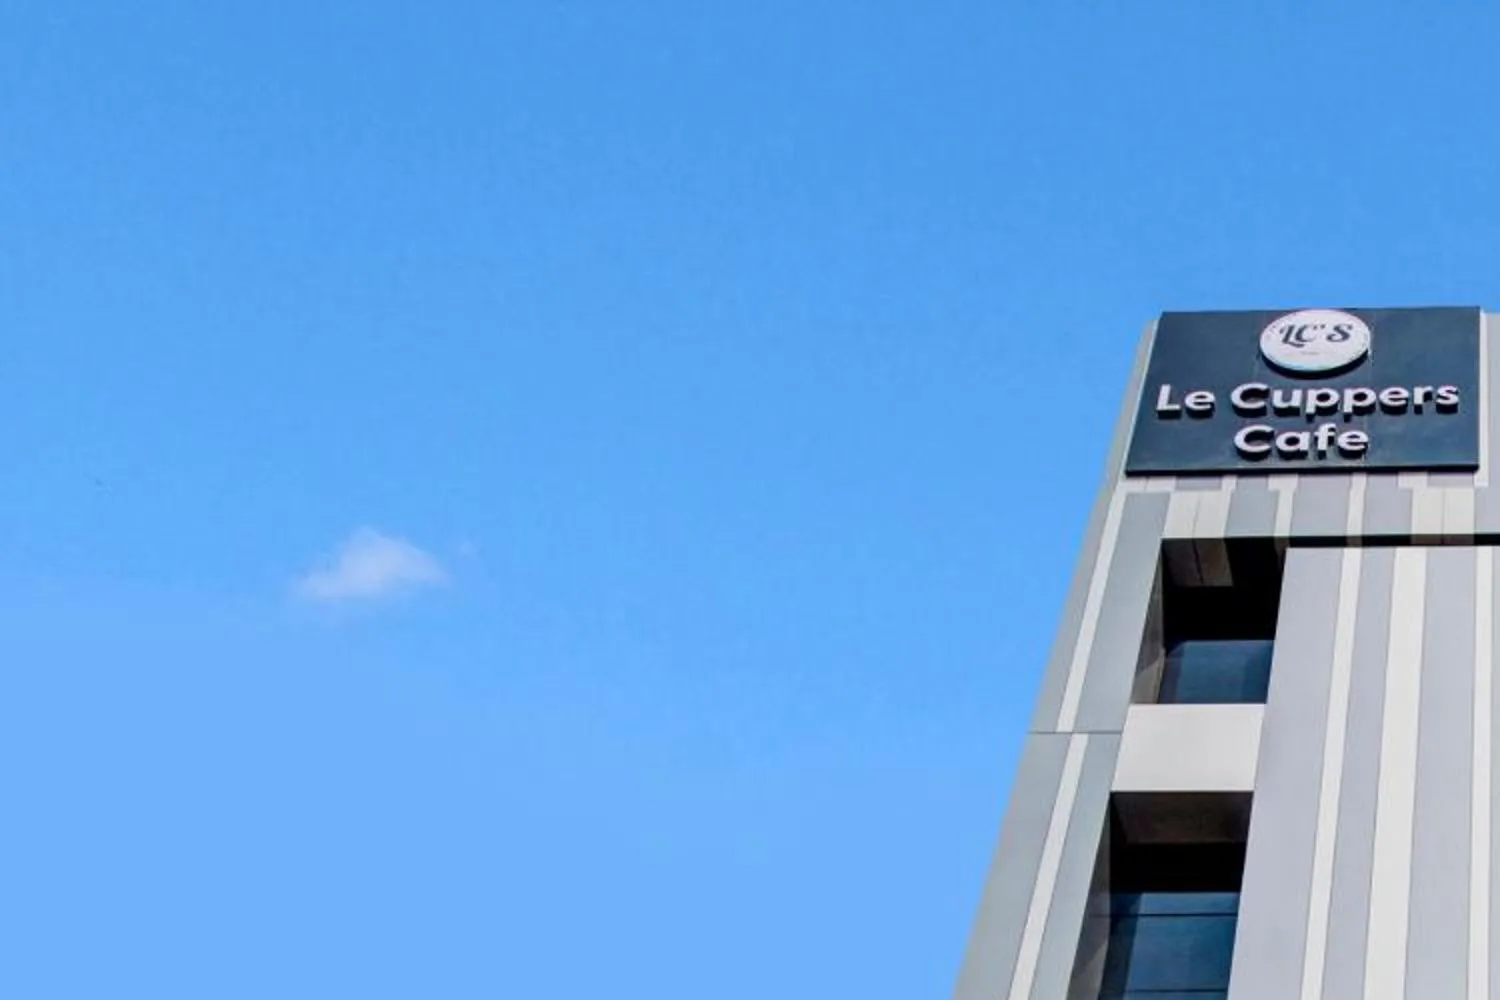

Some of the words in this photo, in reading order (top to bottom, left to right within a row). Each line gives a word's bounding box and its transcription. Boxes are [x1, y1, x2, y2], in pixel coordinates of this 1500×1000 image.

[1155, 385, 1215, 416] Le
[1230, 382, 1459, 422] Cuppers
[1233, 424, 1369, 456] Cafe
